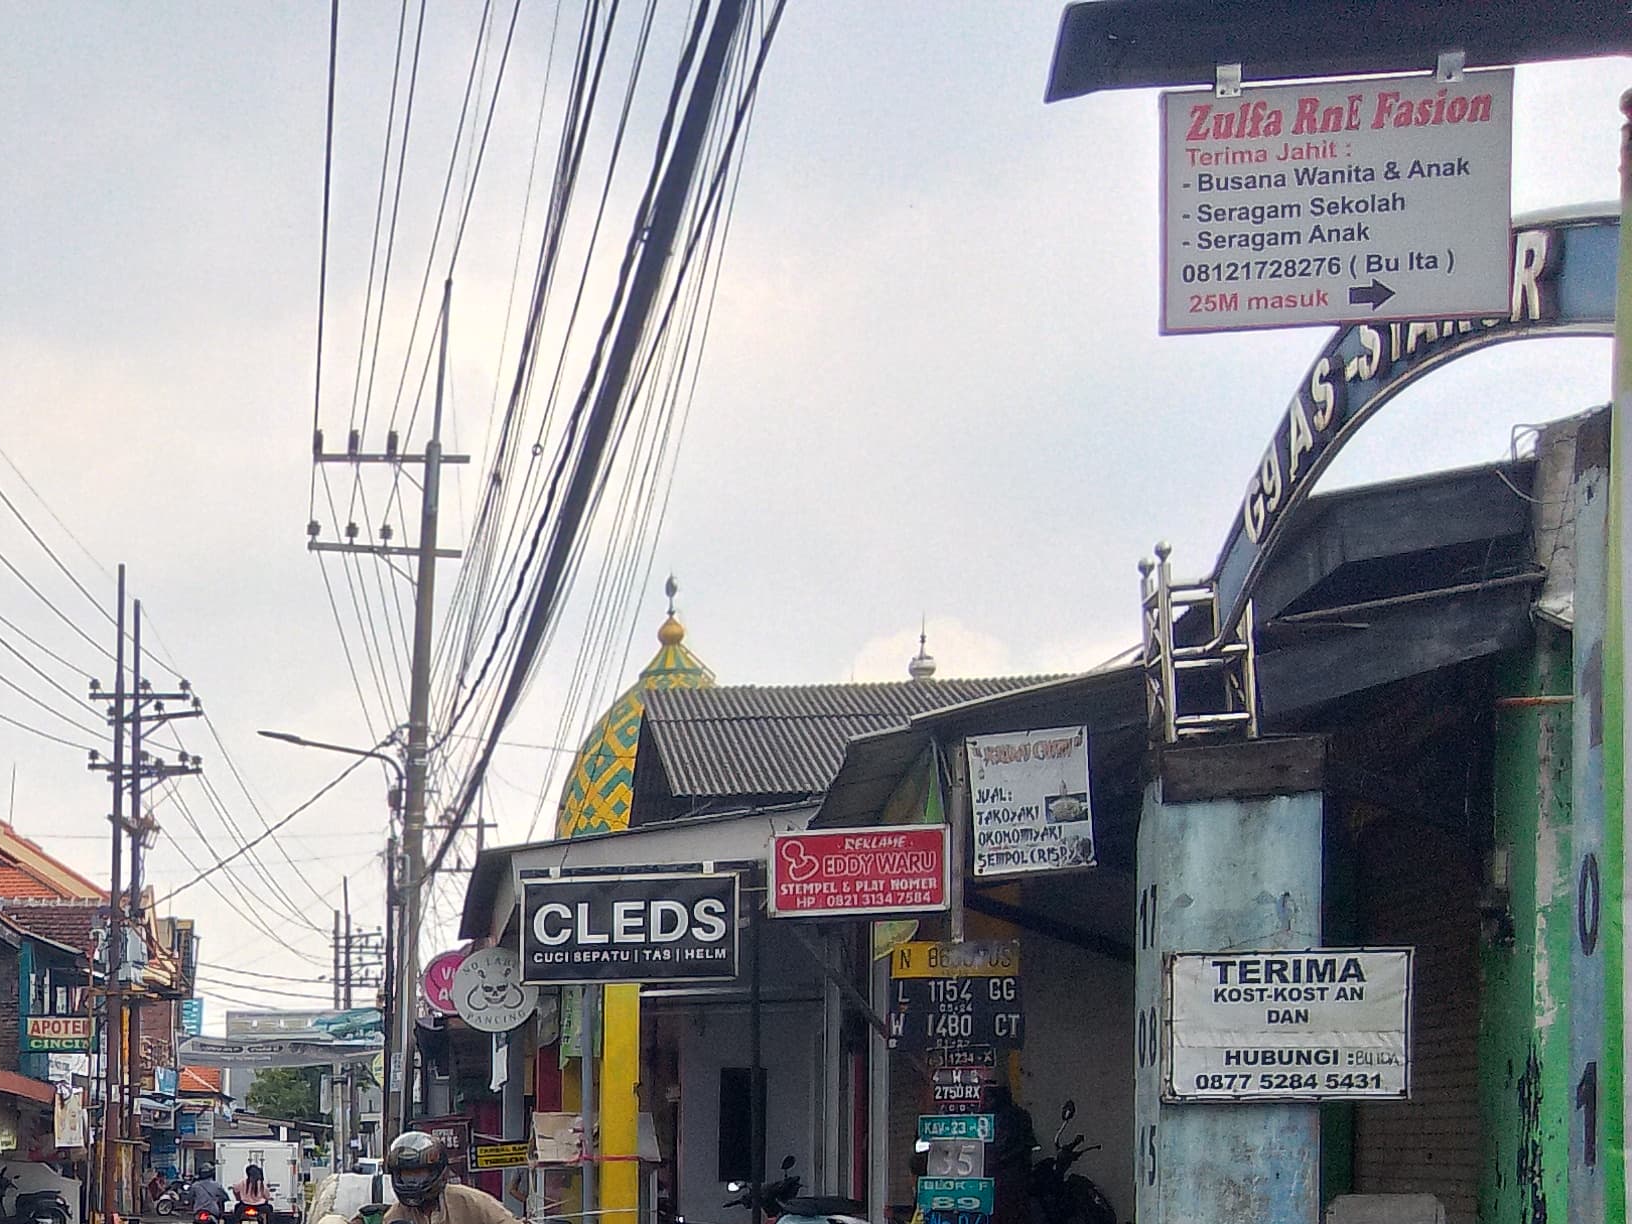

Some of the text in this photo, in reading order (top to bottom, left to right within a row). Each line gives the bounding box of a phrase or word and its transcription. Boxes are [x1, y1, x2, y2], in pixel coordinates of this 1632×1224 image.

[1186, 89, 1492, 141] Zulfa RnE Fasion
[1185, 147, 1267, 167] Terima
[1198, 157, 1470, 192] Busana Wanita & Anak
[1197, 192, 1406, 226] Seragam Sekolah
[1197, 223, 1370, 251] Seragam Anak
[1183, 255, 1341, 283] 08121728276
[1189, 289, 1329, 313] 25M masuk
[976, 806, 1039, 825] TAKOYAKI
[823, 850, 936, 876] EDDY WARU
[978, 850, 1027, 867] SEMPOL
[780, 877, 937, 896] STEMPEL & PLAT NOMER
[797, 897, 815, 909] HP
[827, 893, 858, 907] 0821
[862, 893, 892, 905] 3134
[533, 898, 727, 946] CLEDS
[533, 948, 726, 964] CUCI SEPATU TAS HELM
[900, 948, 911, 969] N
[1212, 958, 1366, 985] TERIMA
[898, 981, 909, 1002] L
[928, 979, 972, 1003] 1154
[1214, 986, 1364, 1003] KOST-KOST AN
[891, 1013, 1020, 1038] W 1480 CT
[1267, 1009, 1309, 1024] DAN
[1225, 1050, 1338, 1066] HUBUNGI
[1195, 1073, 1382, 1090] 0877 5284 5431
[932, 1196, 981, 1211] 89
